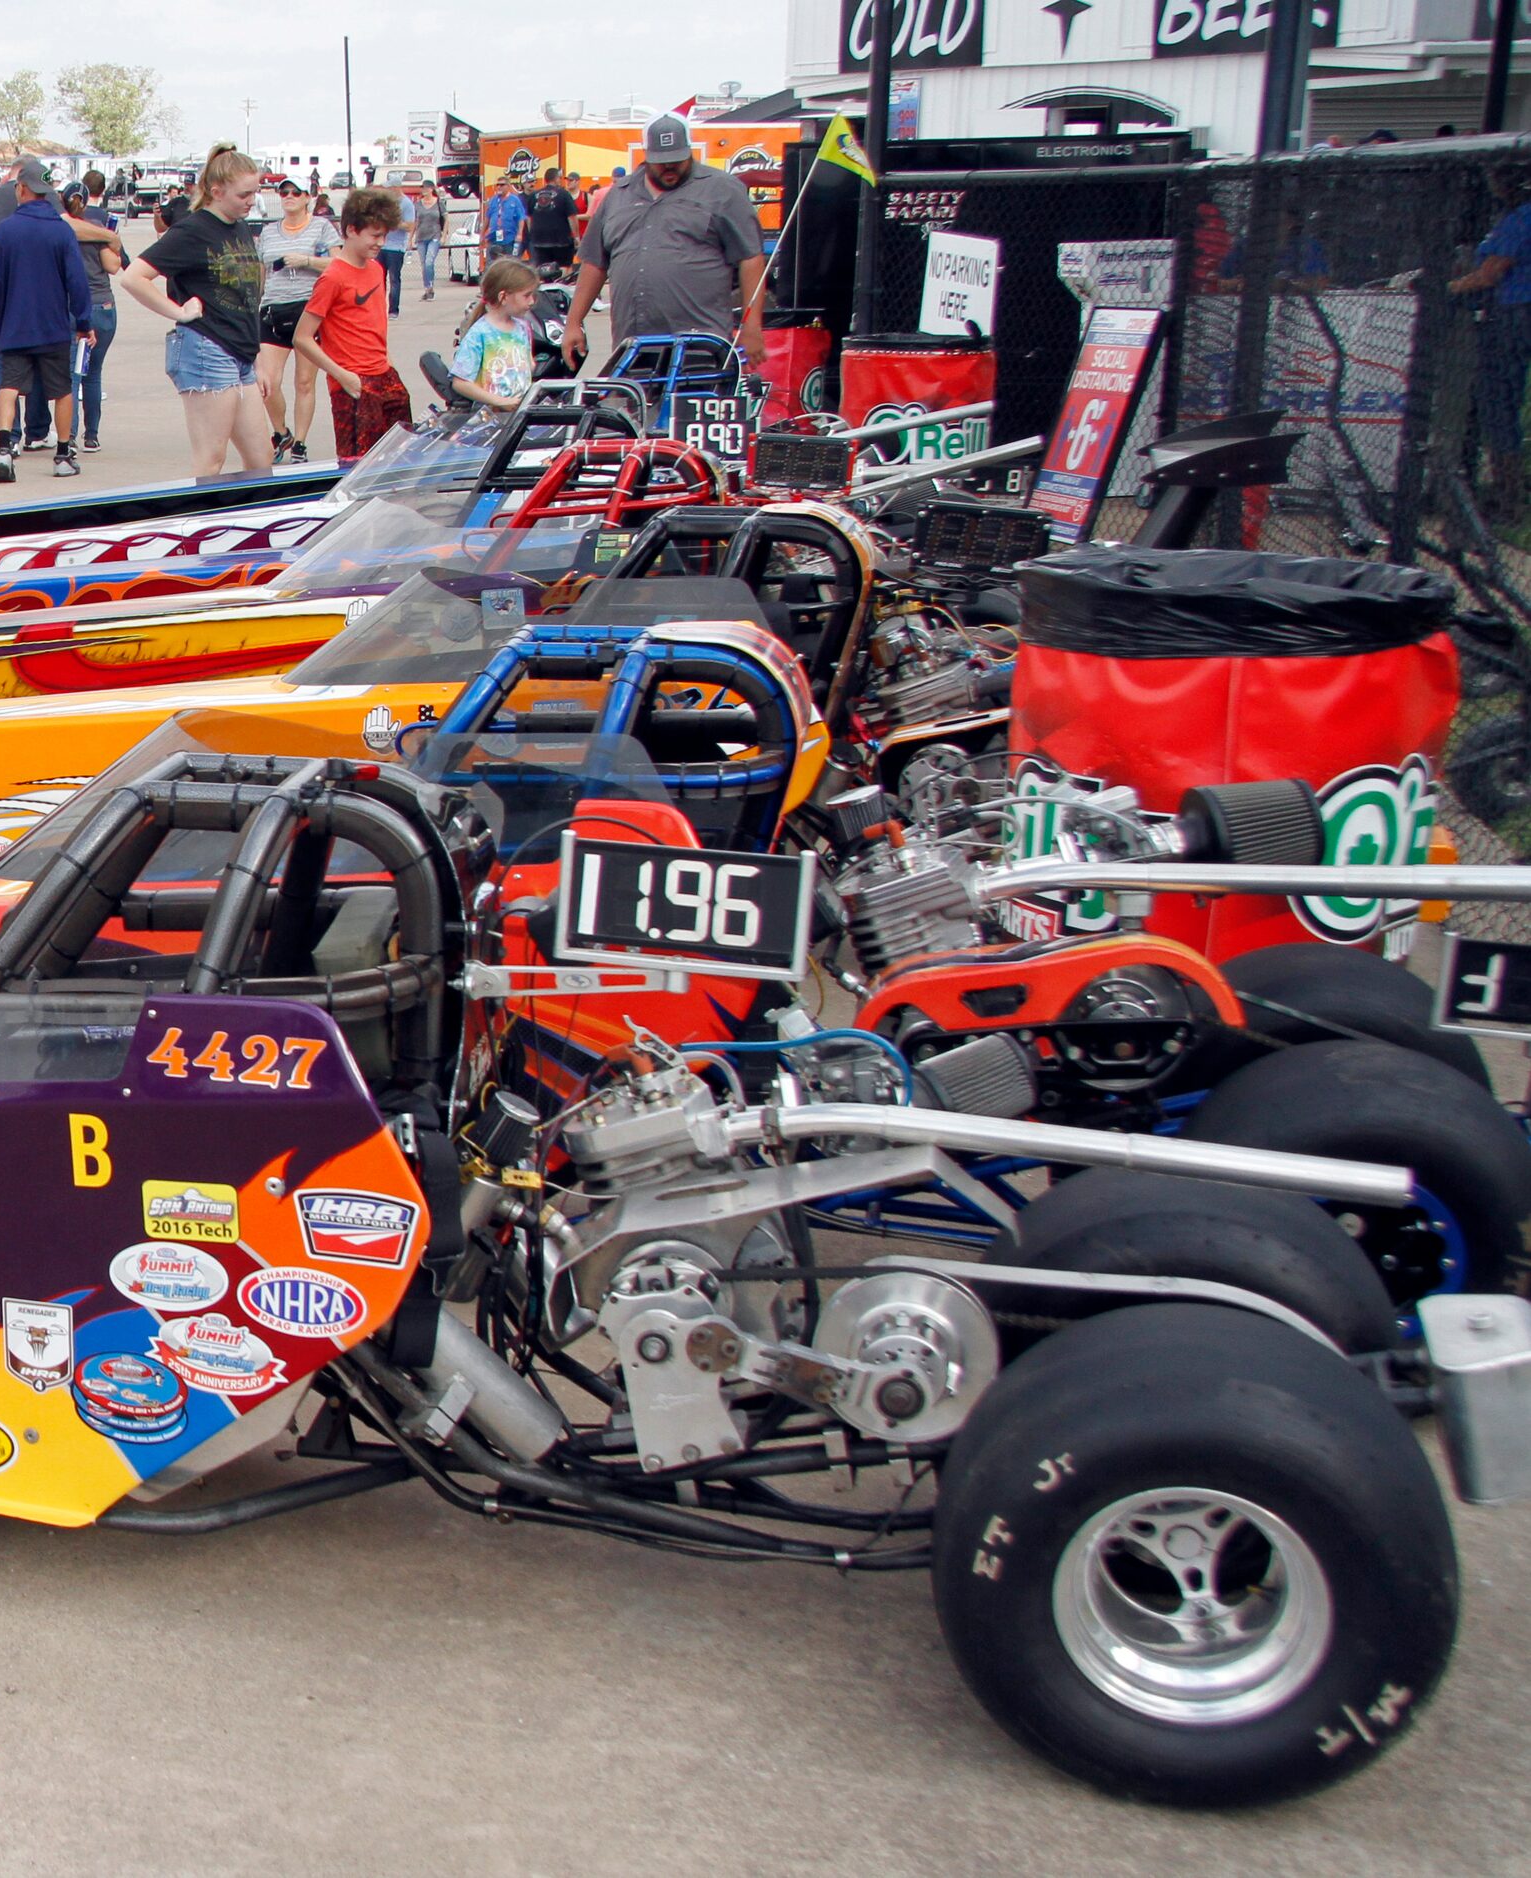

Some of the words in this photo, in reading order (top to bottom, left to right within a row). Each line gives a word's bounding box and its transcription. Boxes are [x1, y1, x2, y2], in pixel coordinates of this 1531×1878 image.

[1156, 0, 1328, 45] BEE
[1036, 144, 1133, 158] ELECTRONICS
[887, 191, 966, 206] SAFETY
[929, 252, 944, 279] NO
[944, 255, 990, 288] PARKING
[938, 291, 968, 322] HERE
[1091, 349, 1128, 370] SOCIAL
[1073, 370, 1134, 393] DISTANCING
[999, 899, 1051, 942] ARTS
[146, 1027, 327, 1089] 4427
[69, 1113, 112, 1187] B
[149, 1197, 183, 1216] SAN
[185, 1200, 232, 1216] ANTONIO
[309, 1198, 403, 1222] IHRA
[152, 1220, 192, 1235] 2016
[195, 1223, 232, 1238] Tech
[308, 1213, 404, 1230] MOTORSPORTS
[139, 1253, 195, 1275] SUMMIT
[260, 1270, 343, 1290] CHAMPIONSHIP
[18, 1307, 58, 1318] RENEGADES
[260, 1281, 347, 1323] NHRA
[187, 1322, 243, 1346] SUMMIT
[260, 1313, 291, 1330] DRAG
[298, 1324, 341, 1335] RACING
[20, 1367, 62, 1379] IHRA
[168, 1359, 192, 1379] 25th
[194, 1373, 264, 1390] ANNIVERSARY
[34, 1379, 44, 1391] 4
[1032, 1452, 1077, 1492] Jr
[973, 1514, 1014, 1581] ET
